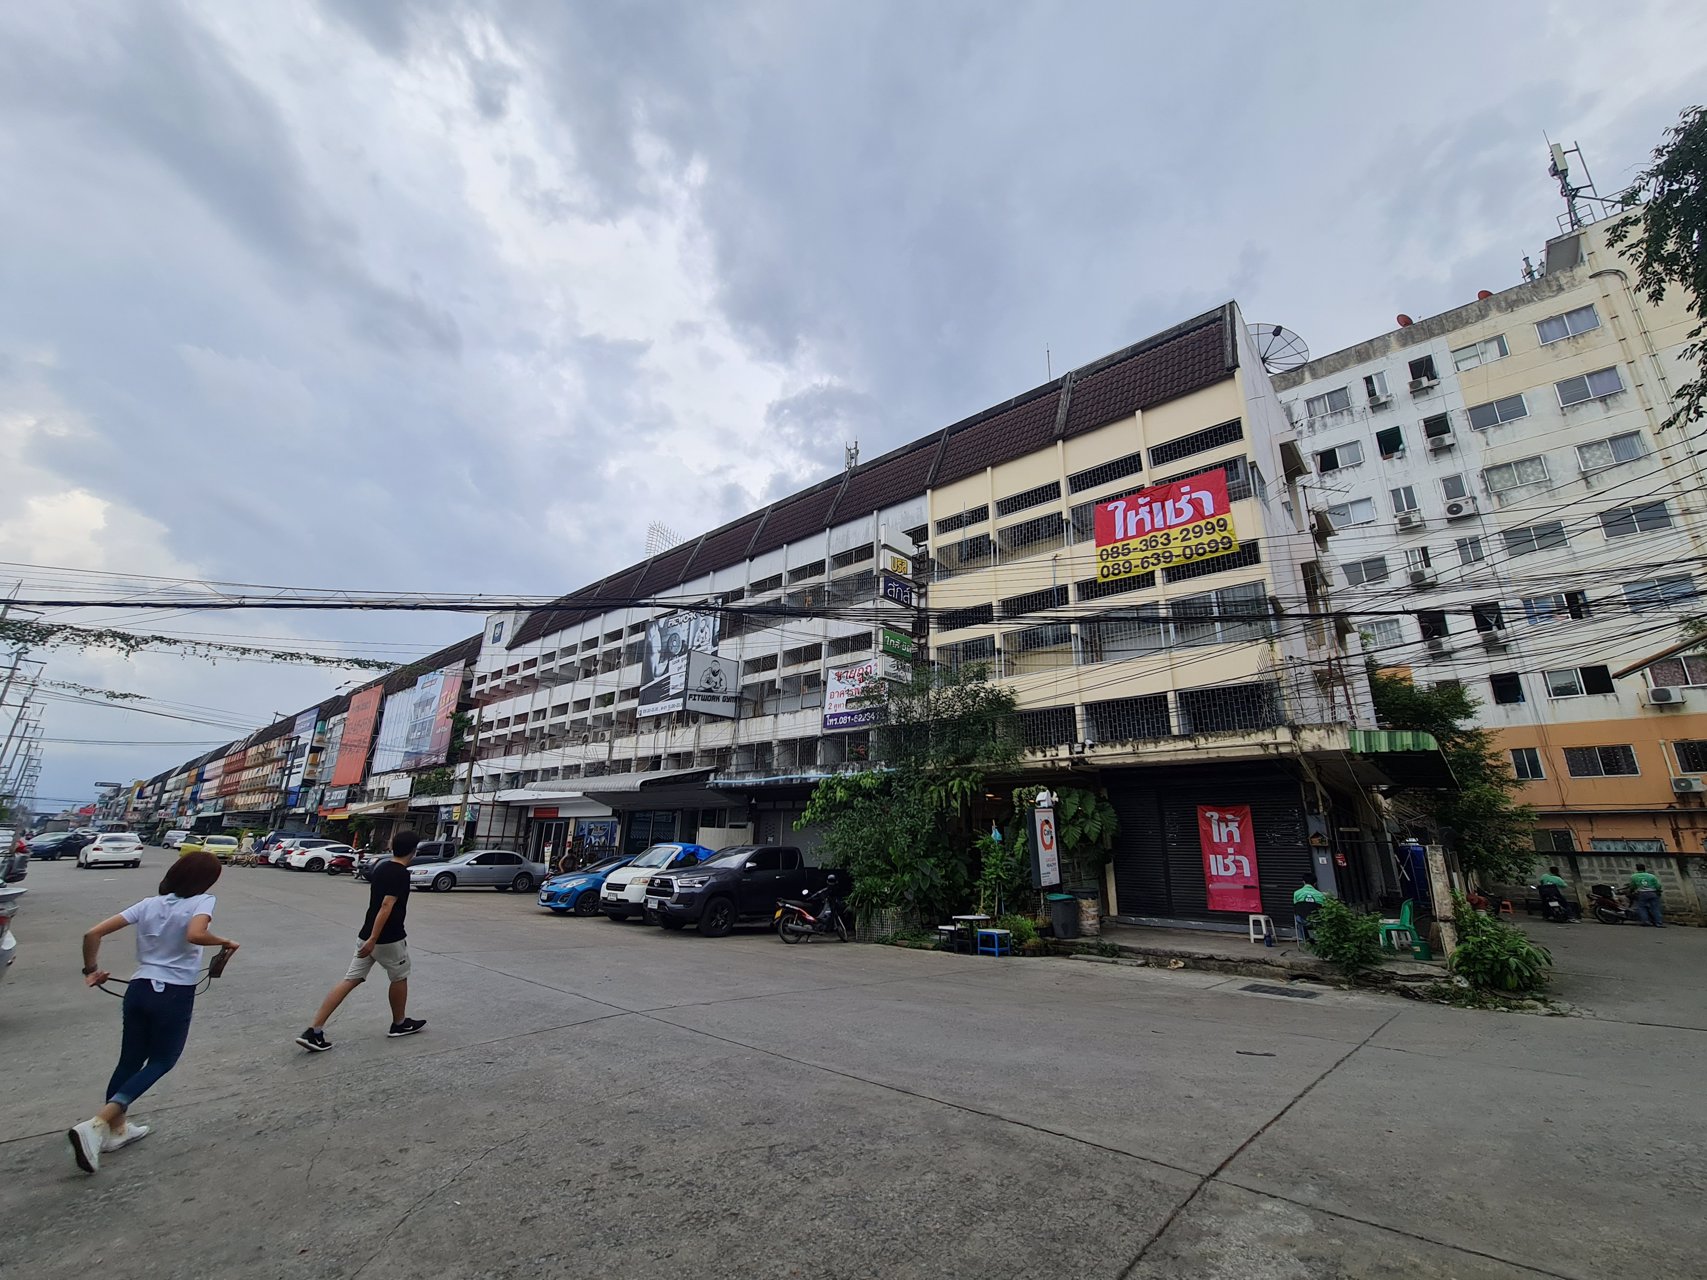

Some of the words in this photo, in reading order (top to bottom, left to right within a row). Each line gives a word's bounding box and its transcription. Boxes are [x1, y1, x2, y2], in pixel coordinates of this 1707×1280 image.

[1107, 486, 1214, 539] ให้เช่า
[1100, 517, 1228, 561] 085-363-2999
[1100, 535, 1233, 579] 089-639-0699
[688, 693, 721, 703] FITWORK
[1205, 811, 1241, 843] ให้
[1209, 848, 1250, 877] เช่า
